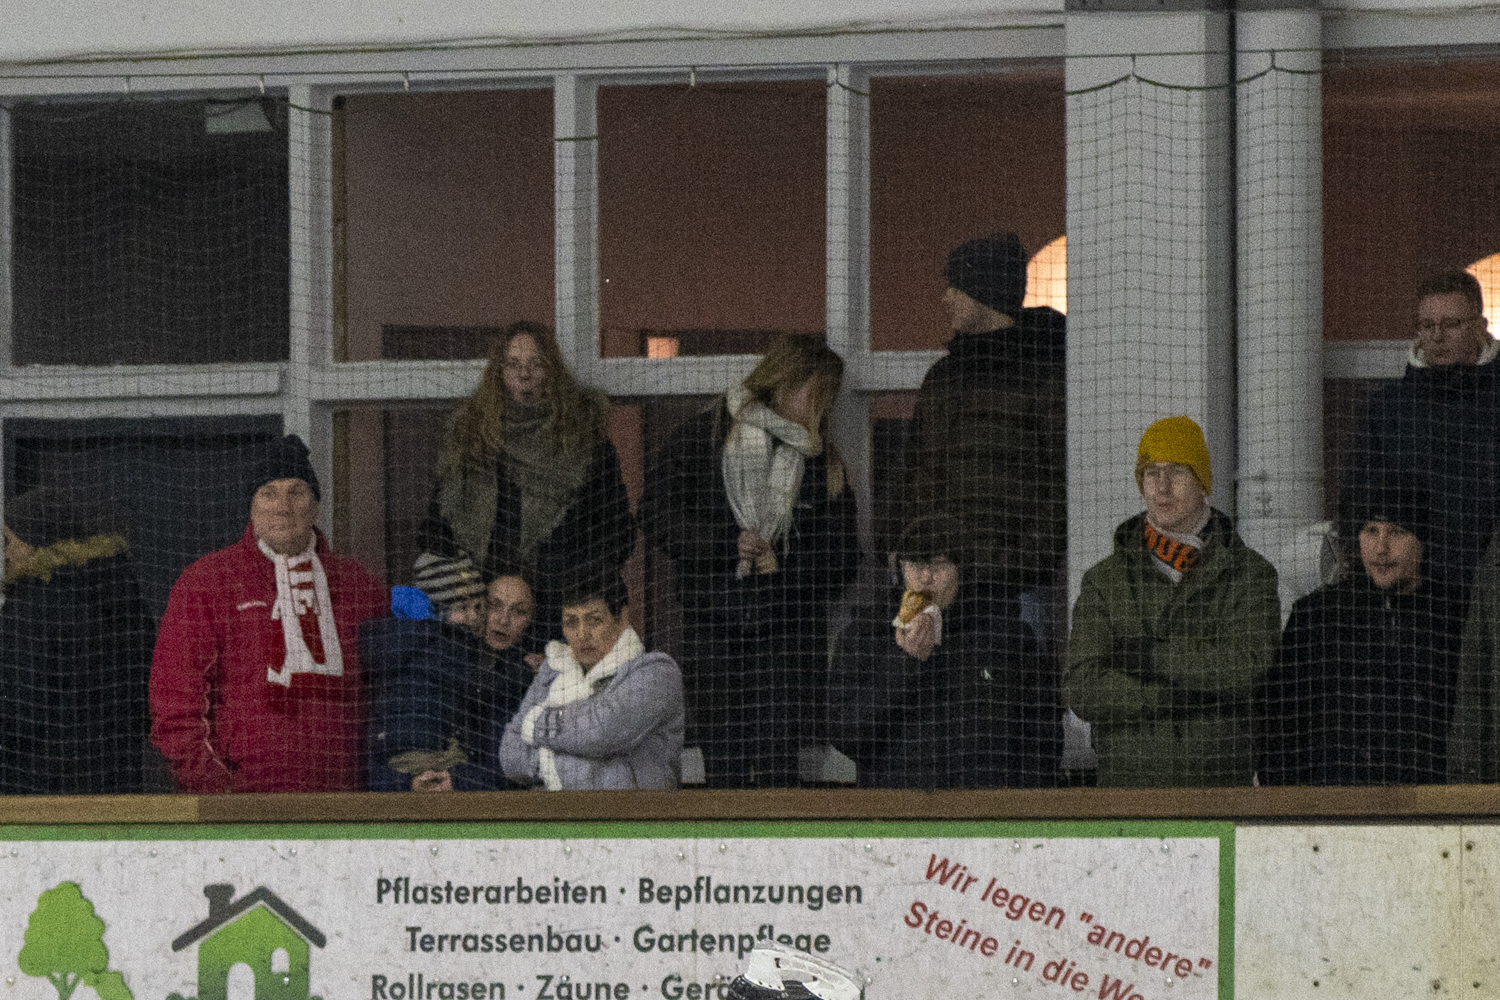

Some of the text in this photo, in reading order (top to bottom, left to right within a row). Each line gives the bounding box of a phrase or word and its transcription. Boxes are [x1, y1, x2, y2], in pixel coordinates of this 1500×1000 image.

[376, 876, 863, 911] Pflasterarbeiten Bepflanzungen
[925, 853, 1213, 979] Wir legen "andere"
[405, 926, 602, 953] Terrassenbau
[904, 901, 1000, 957] Steine
[1004, 940, 1036, 972] in
[1042, 958, 1090, 992] die
[372, 974, 505, 1000] Rollrasen
[536, 974, 629, 1000] Zäune
